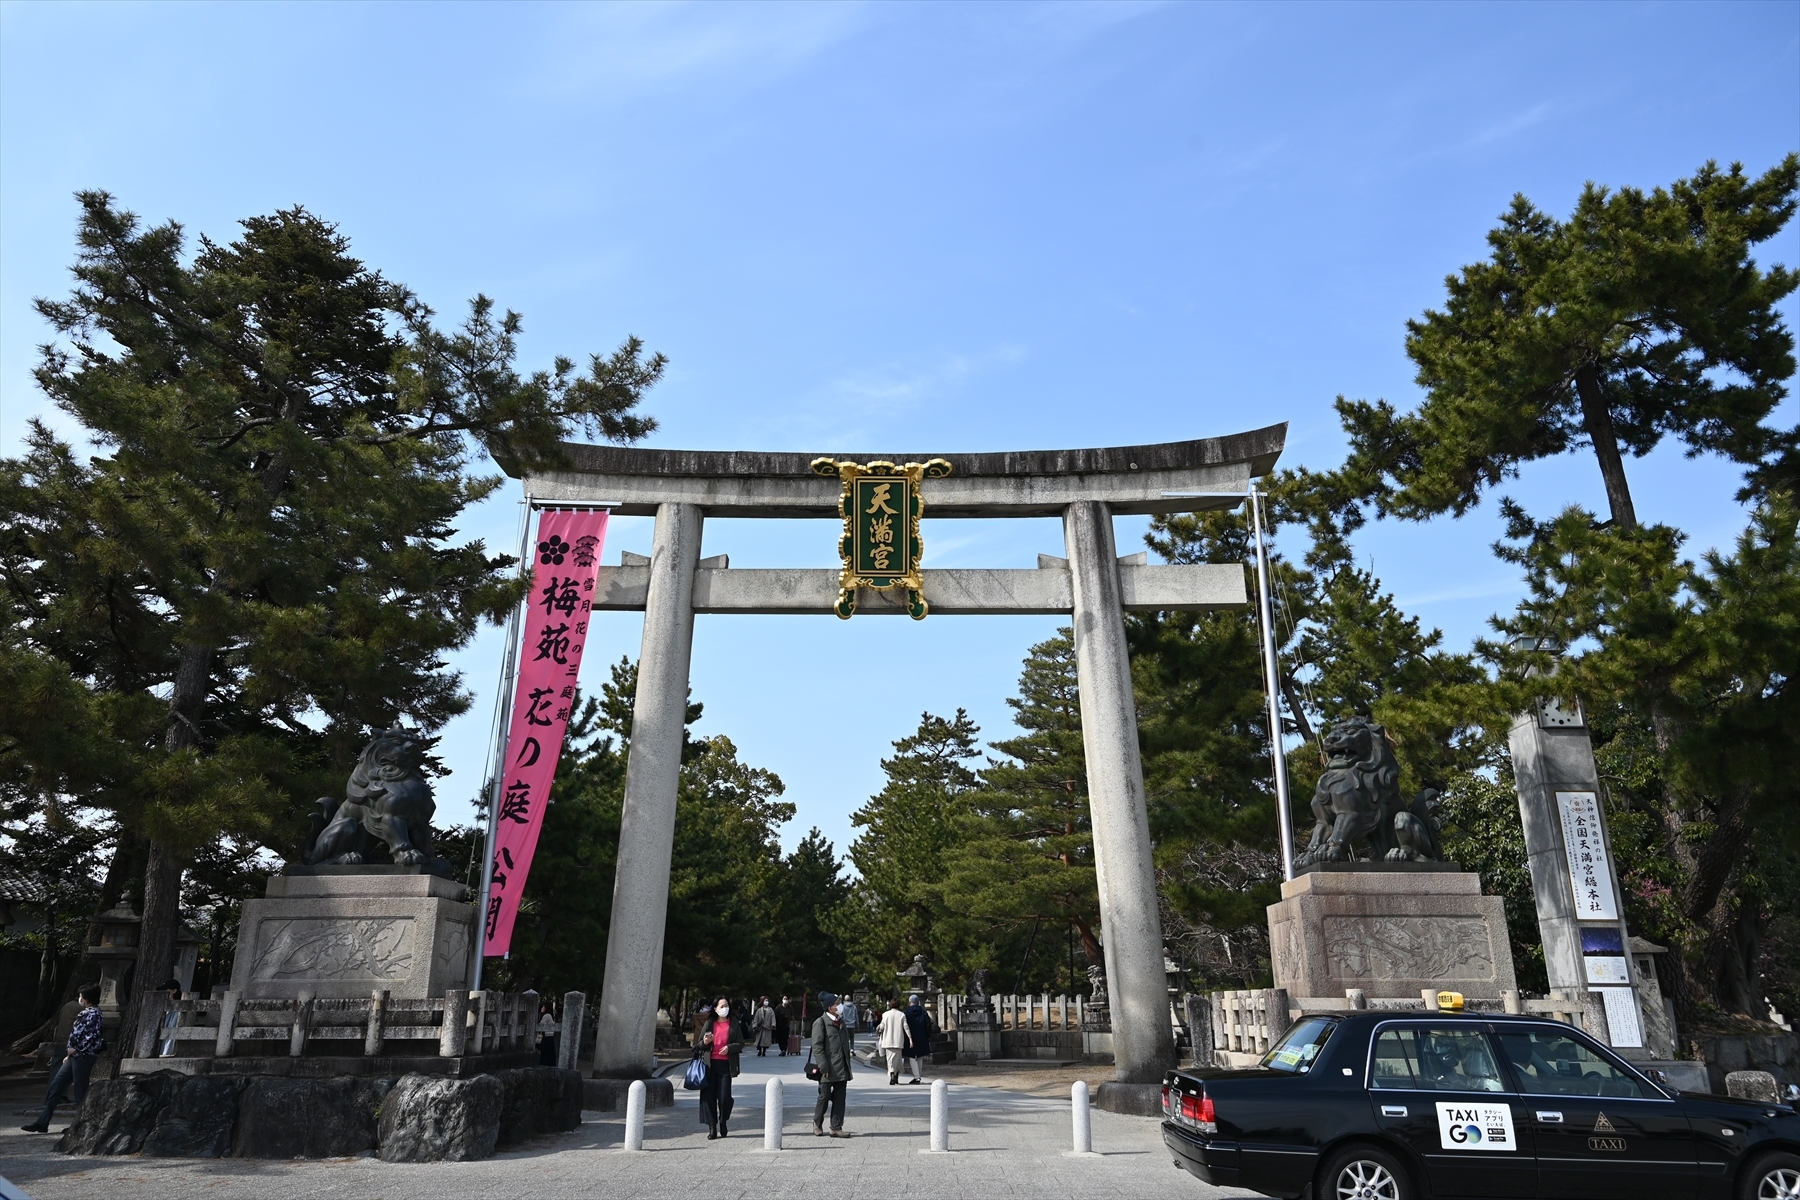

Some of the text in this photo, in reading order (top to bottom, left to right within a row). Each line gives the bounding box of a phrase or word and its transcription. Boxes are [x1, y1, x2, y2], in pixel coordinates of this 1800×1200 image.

[555, 577, 595, 721] 雪月花の三庭苑
[1575, 815, 1602, 912] 全国天満宮総本社
[1446, 1109, 1479, 1122] TAXI
[1449, 1124, 1482, 1144] GO
[1591, 1139, 1623, 1149] TAXI
